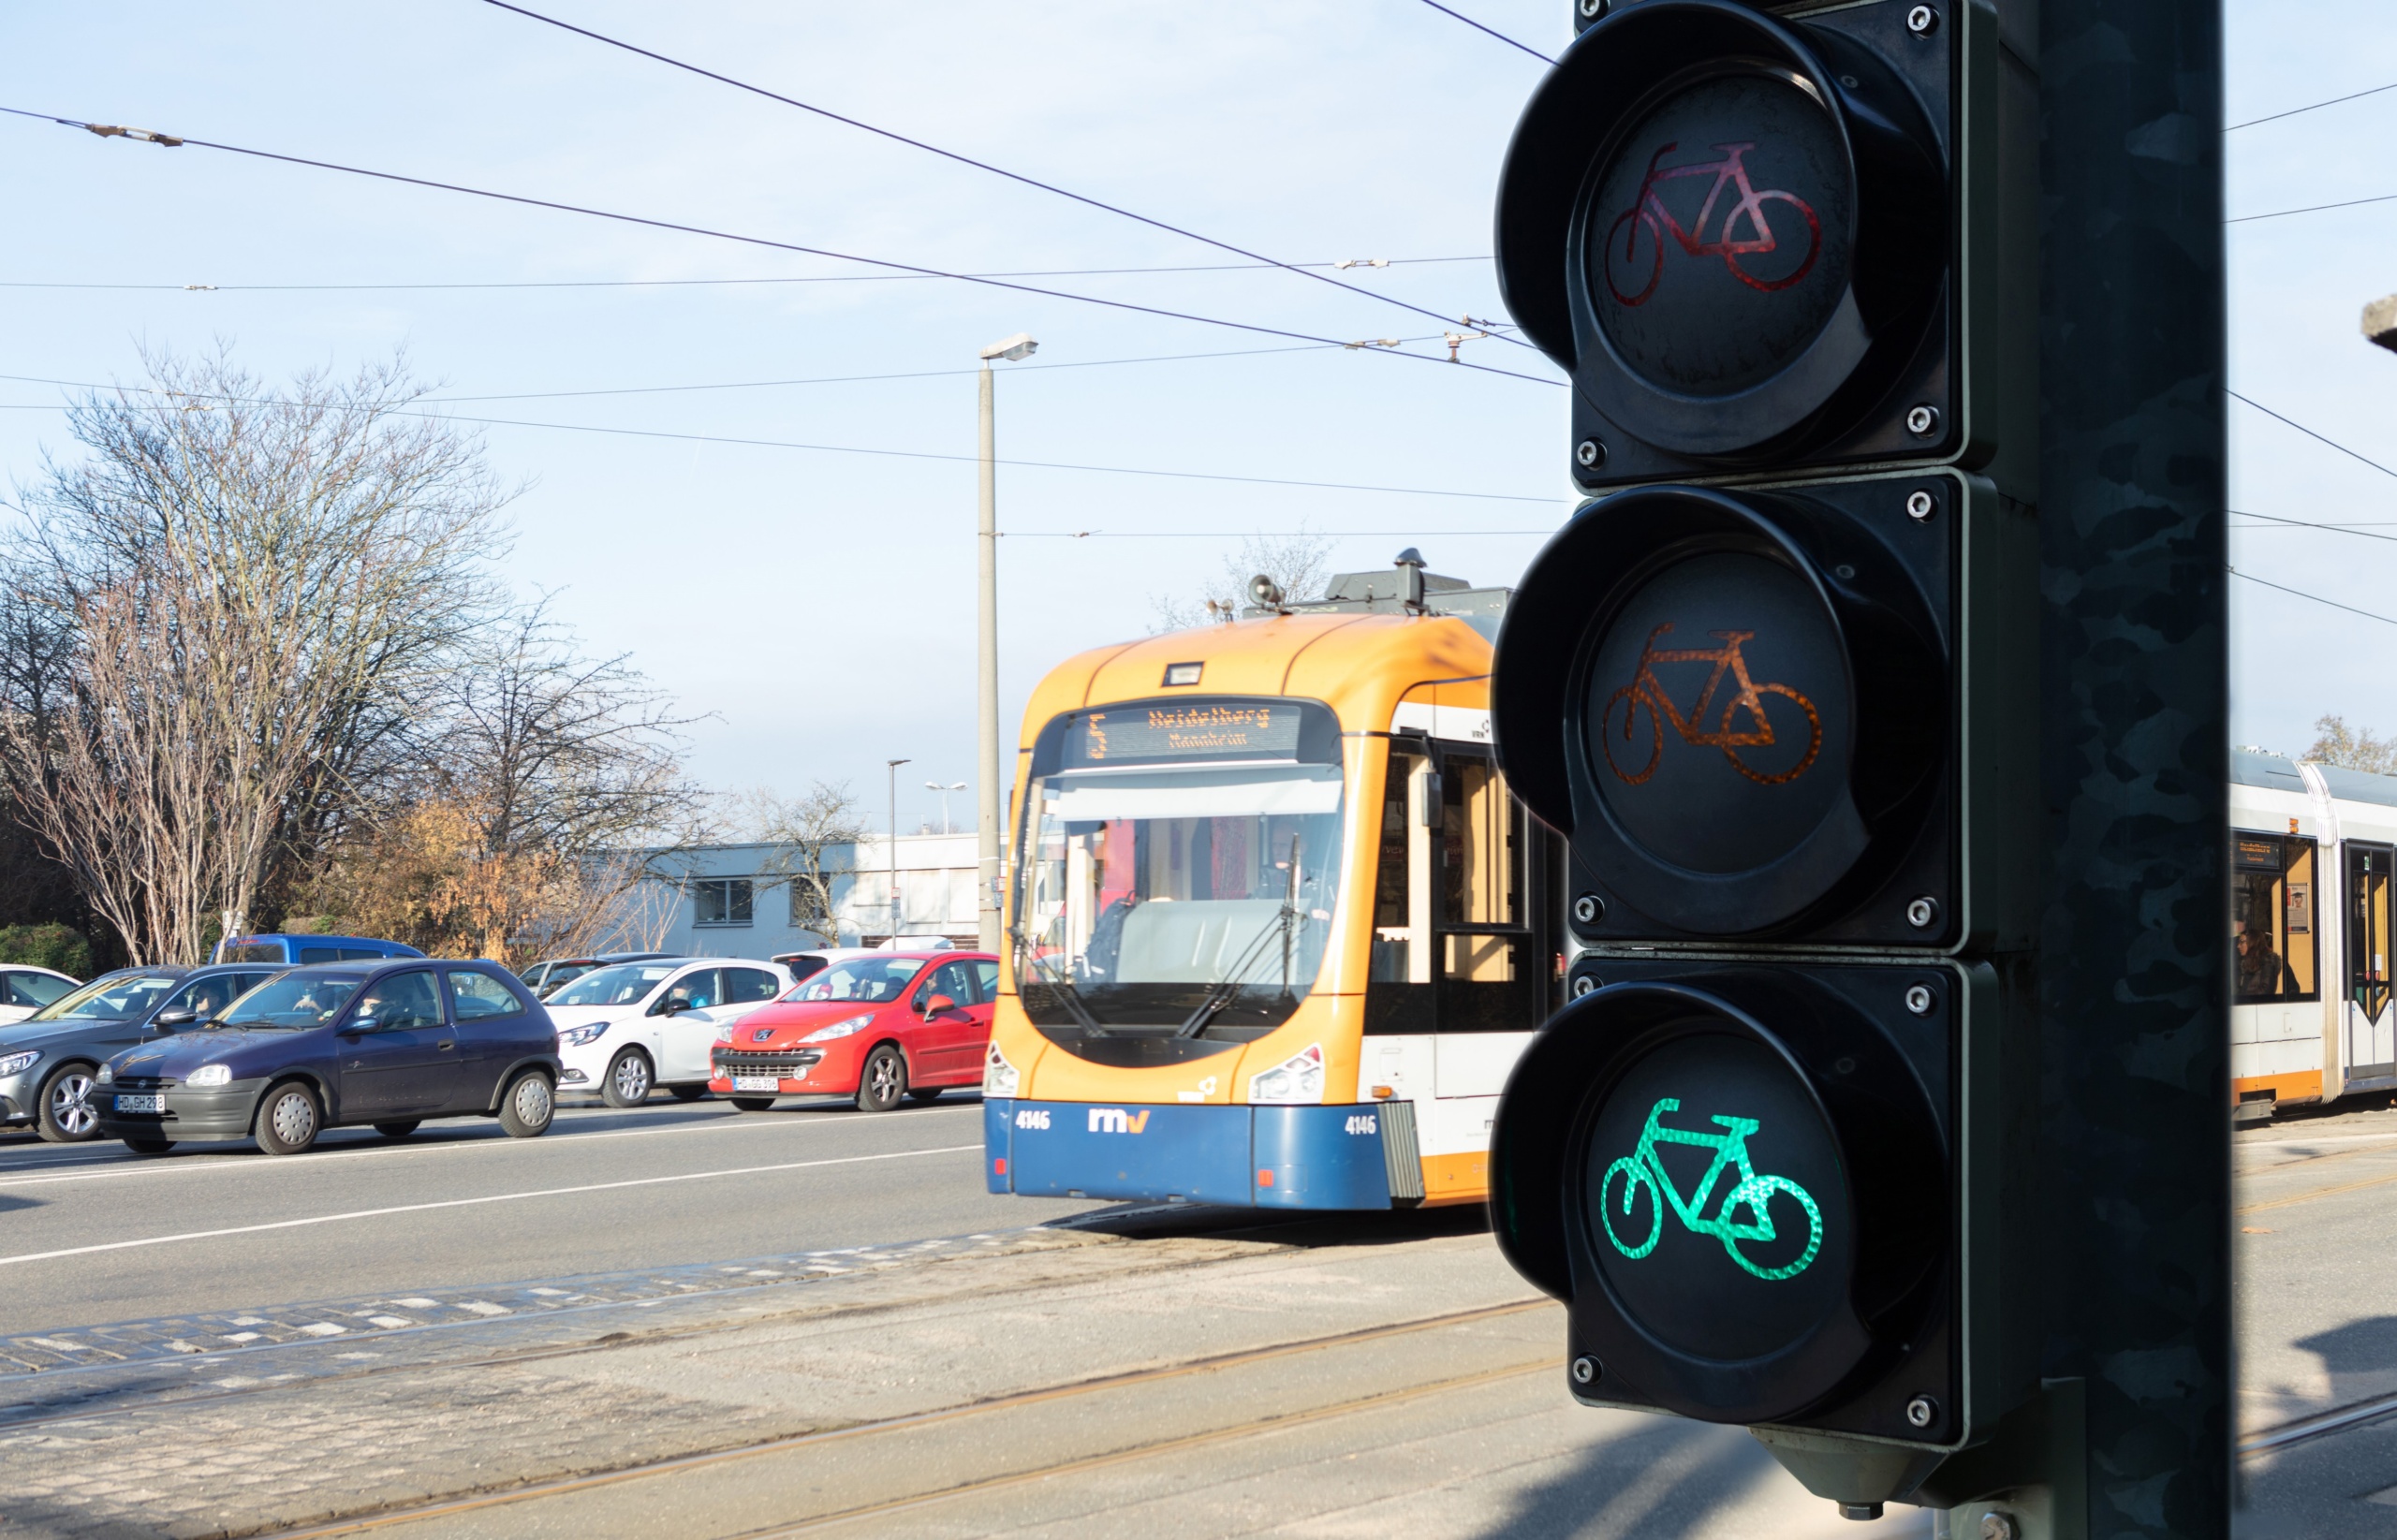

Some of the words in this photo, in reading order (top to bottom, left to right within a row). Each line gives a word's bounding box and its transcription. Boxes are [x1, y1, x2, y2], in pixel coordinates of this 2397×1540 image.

[1148, 708, 1270, 728] Heidelberg
[1089, 713, 1107, 759] 5
[1016, 1110, 1051, 1130] 4146
[1346, 1115, 1376, 1135] 4146
